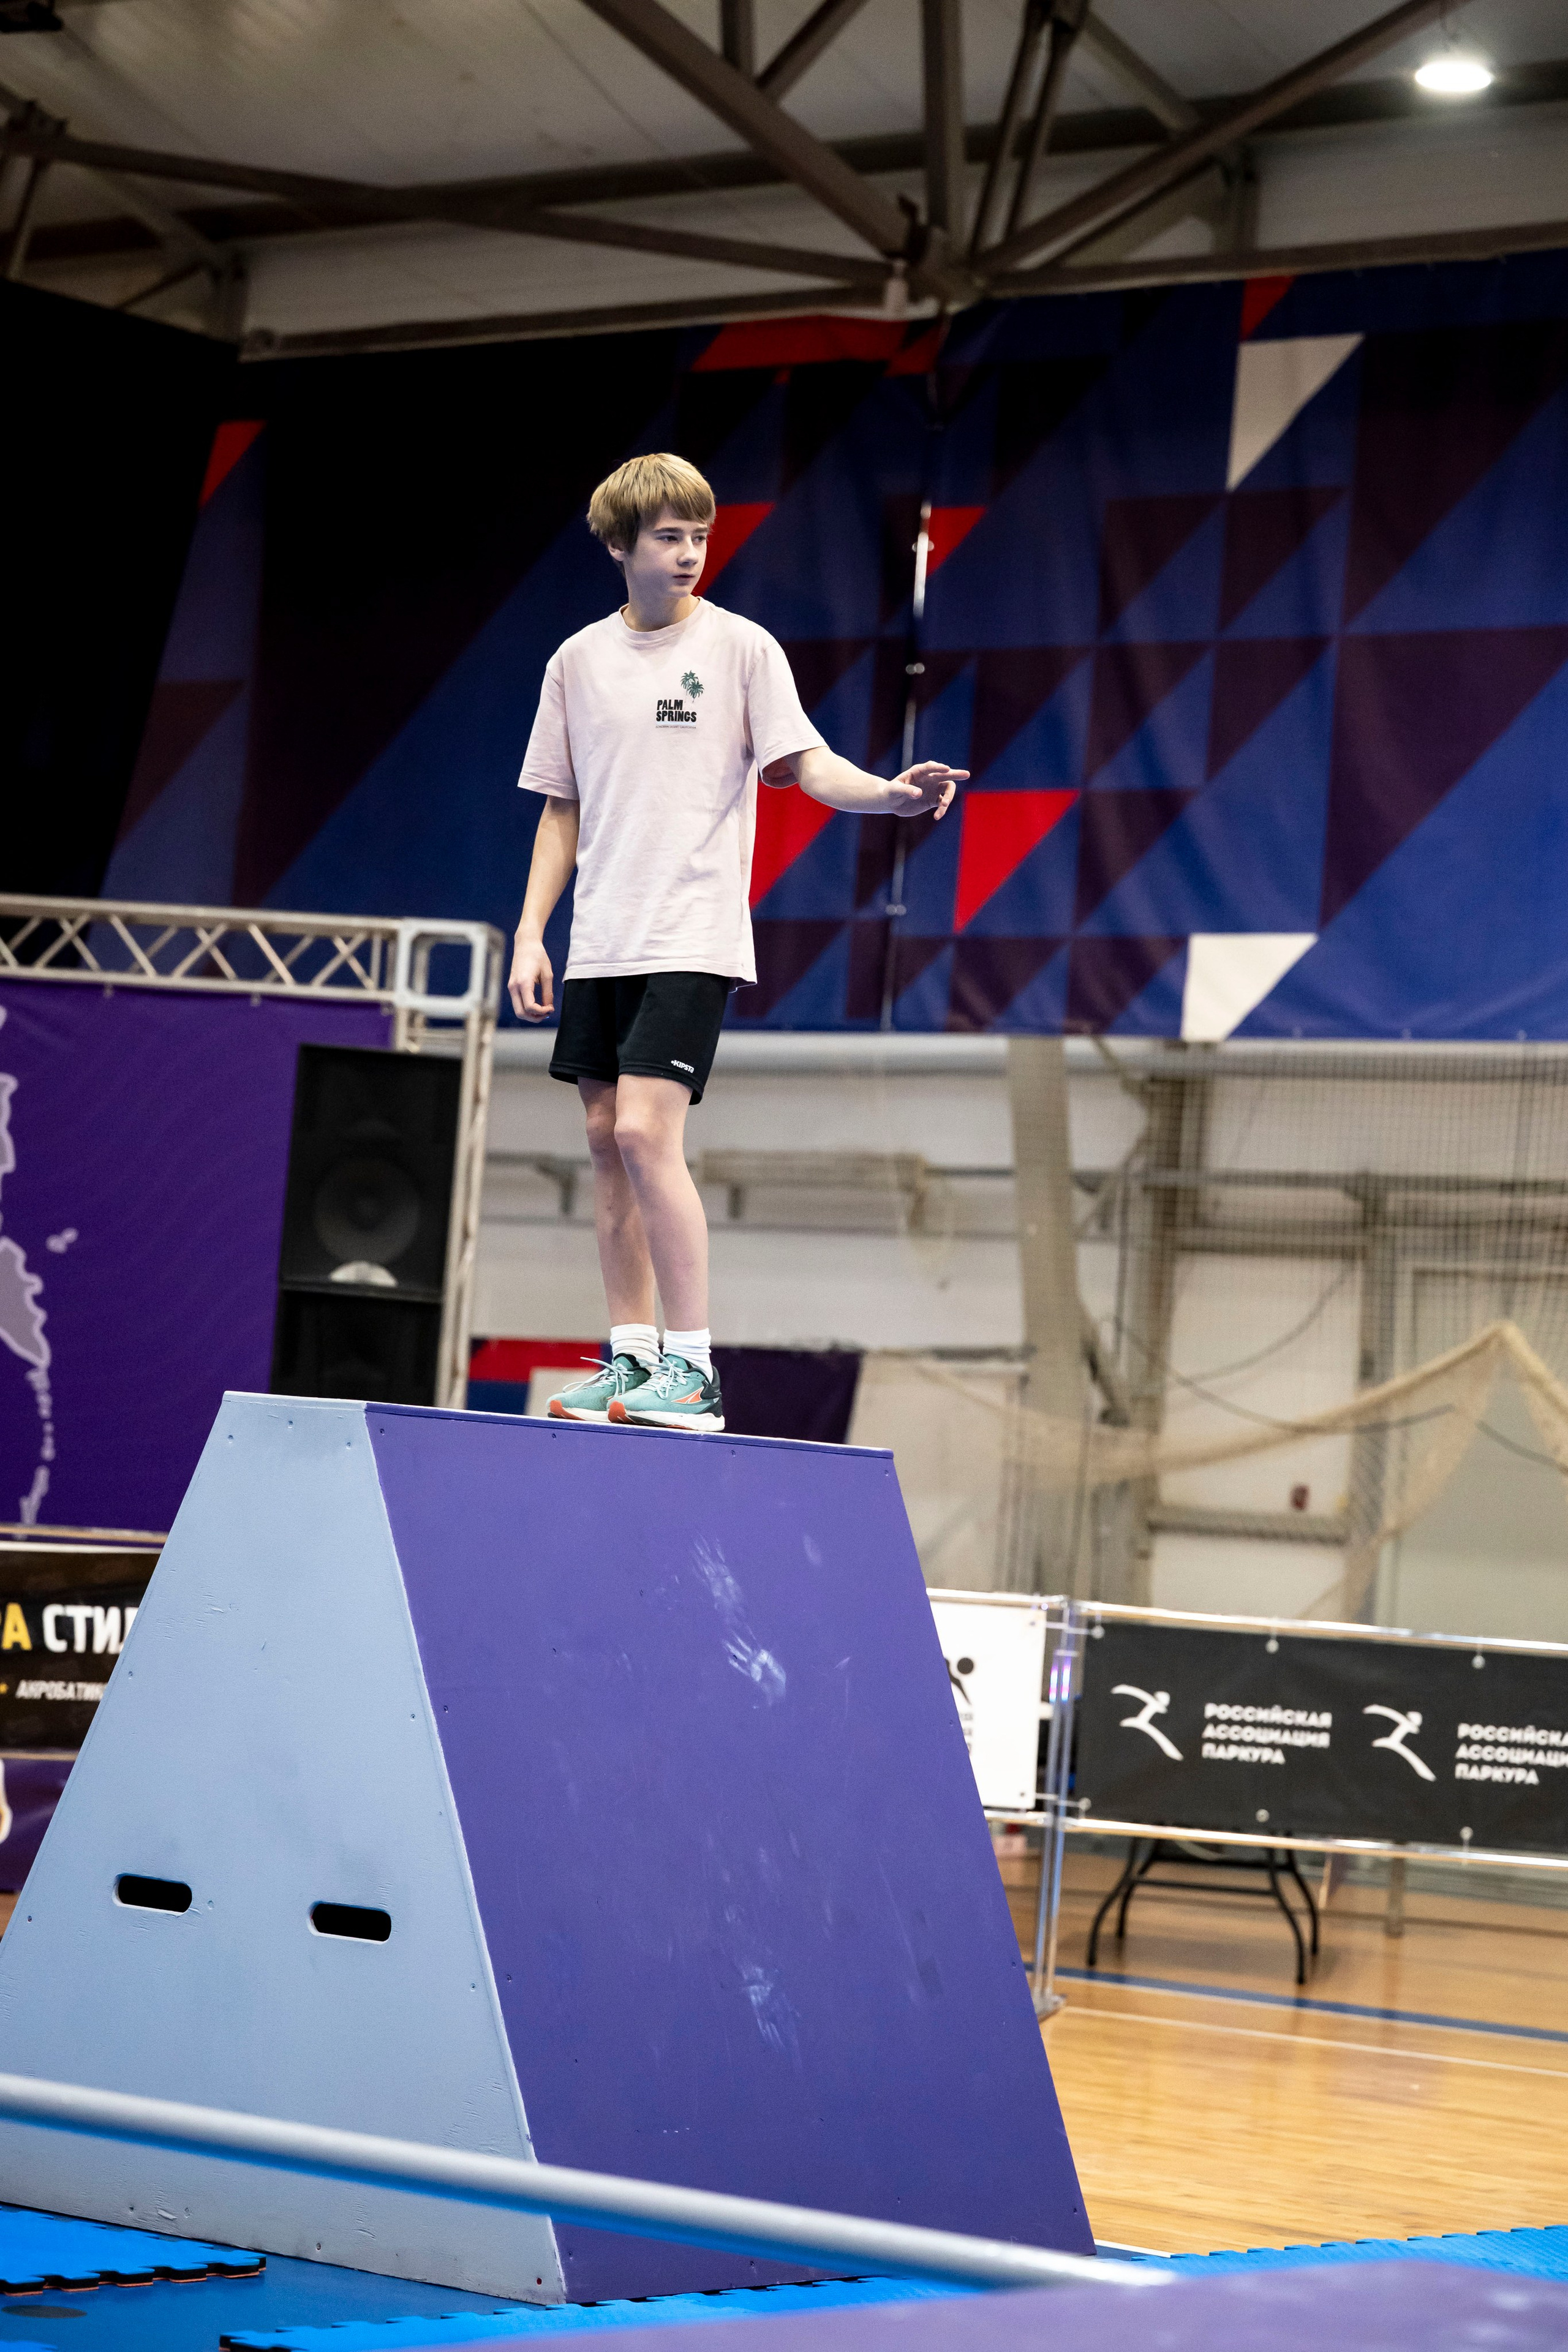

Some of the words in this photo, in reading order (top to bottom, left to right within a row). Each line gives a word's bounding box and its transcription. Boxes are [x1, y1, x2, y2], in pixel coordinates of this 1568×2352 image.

[656, 710, 697, 722] SPRINGS
[657, 699, 684, 710] PALM
[0, 1602, 32, 1651] А
[1204, 1702, 1332, 1728] РОССИЙСКАЯ
[1202, 1723, 1330, 1749] АССОЦИАЦИЯ
[1202, 1743, 1286, 1765] ПАРКУРА
[1455, 1762, 1540, 1785] ПАРКУРА
